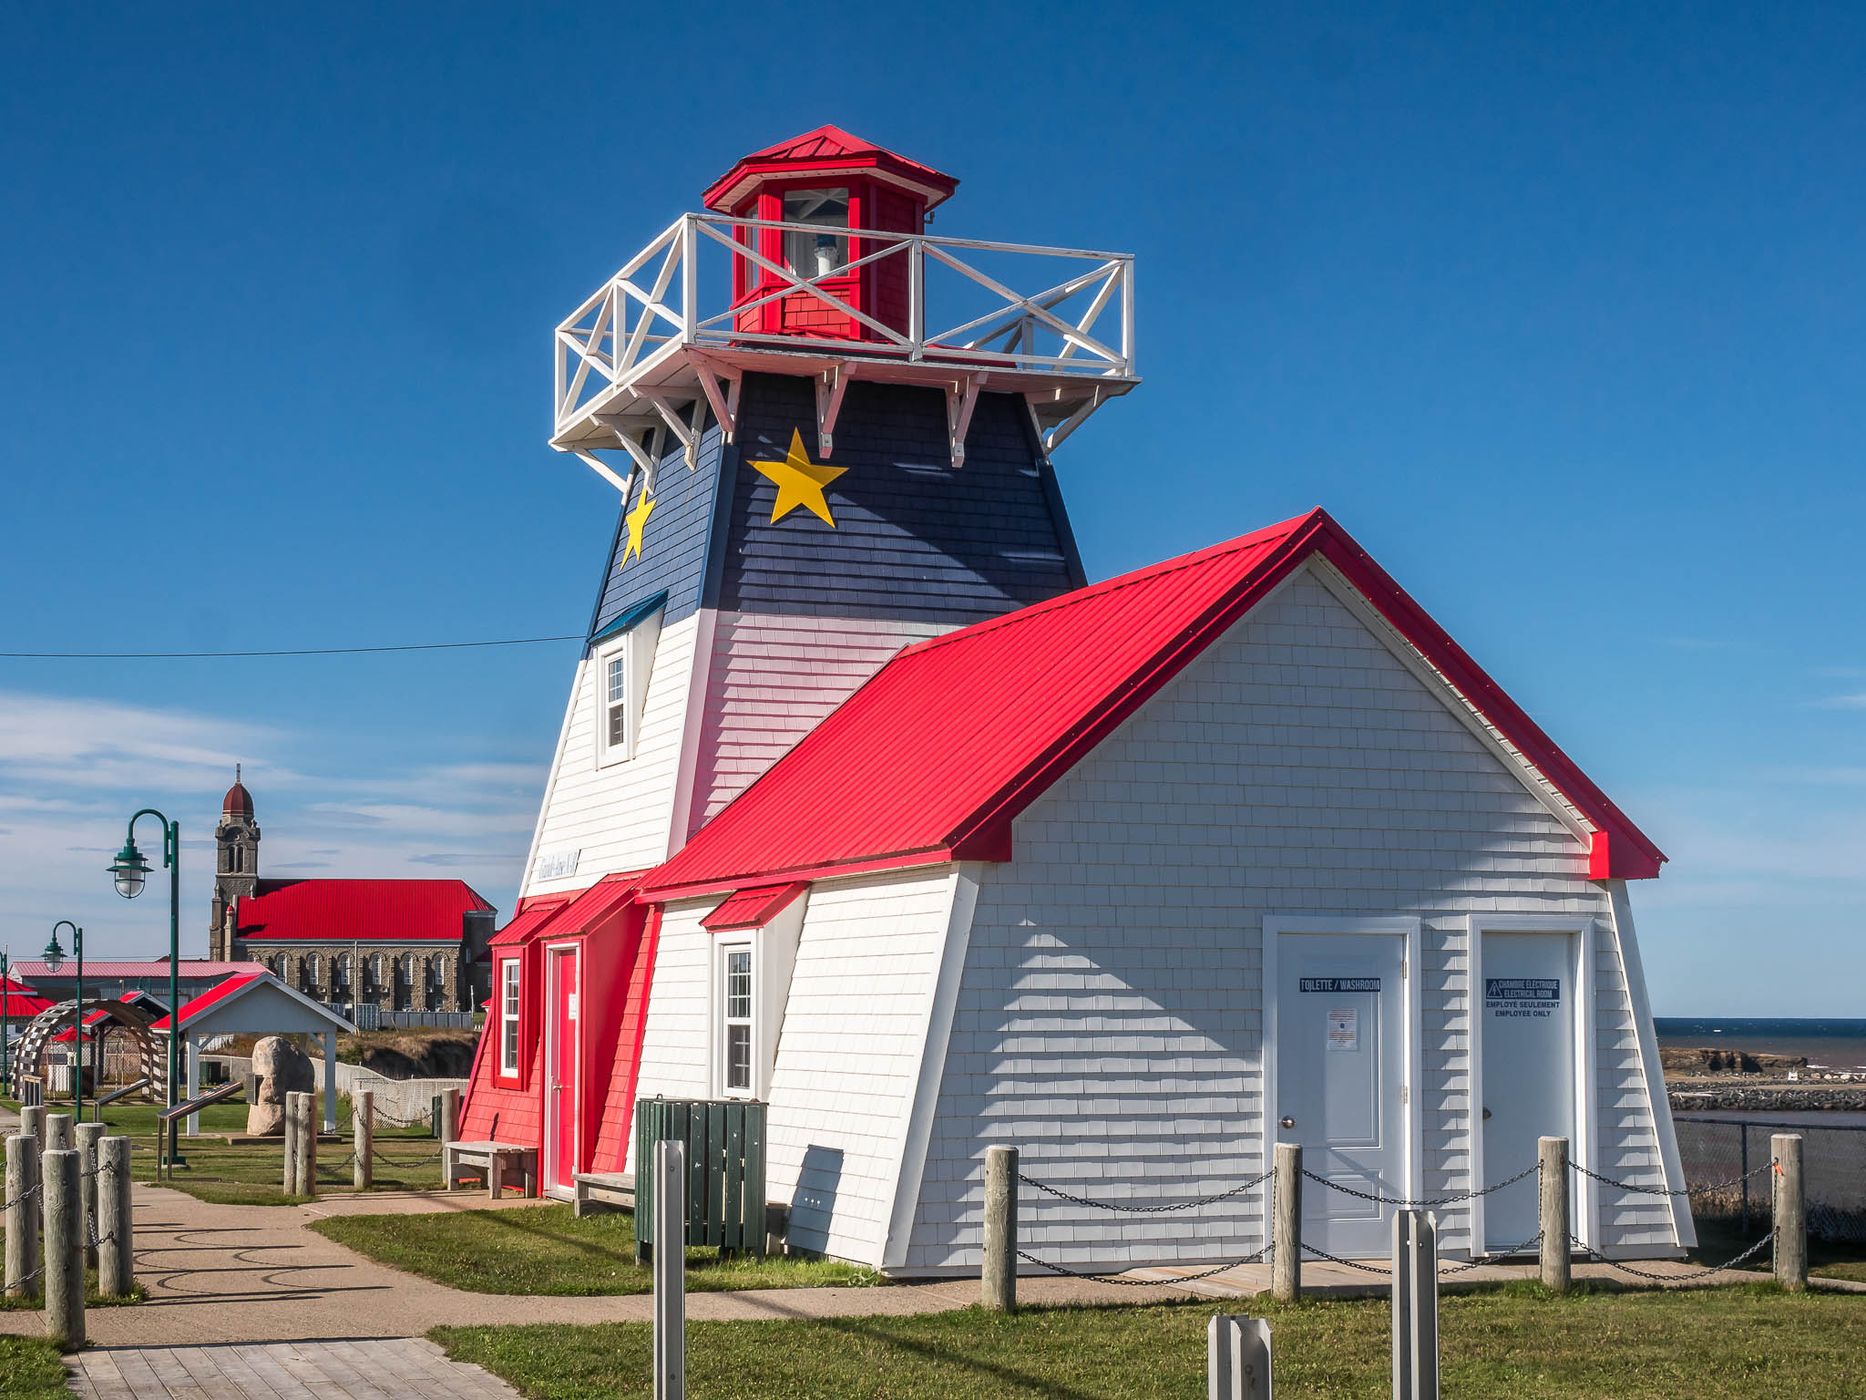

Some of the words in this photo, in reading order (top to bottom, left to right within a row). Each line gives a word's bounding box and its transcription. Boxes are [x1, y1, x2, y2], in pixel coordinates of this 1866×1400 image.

[1340, 980, 1380, 990] WASHROOM
[1504, 989, 1536, 998] ELECTRICAL
[1536, 989, 1553, 998] ROOM
